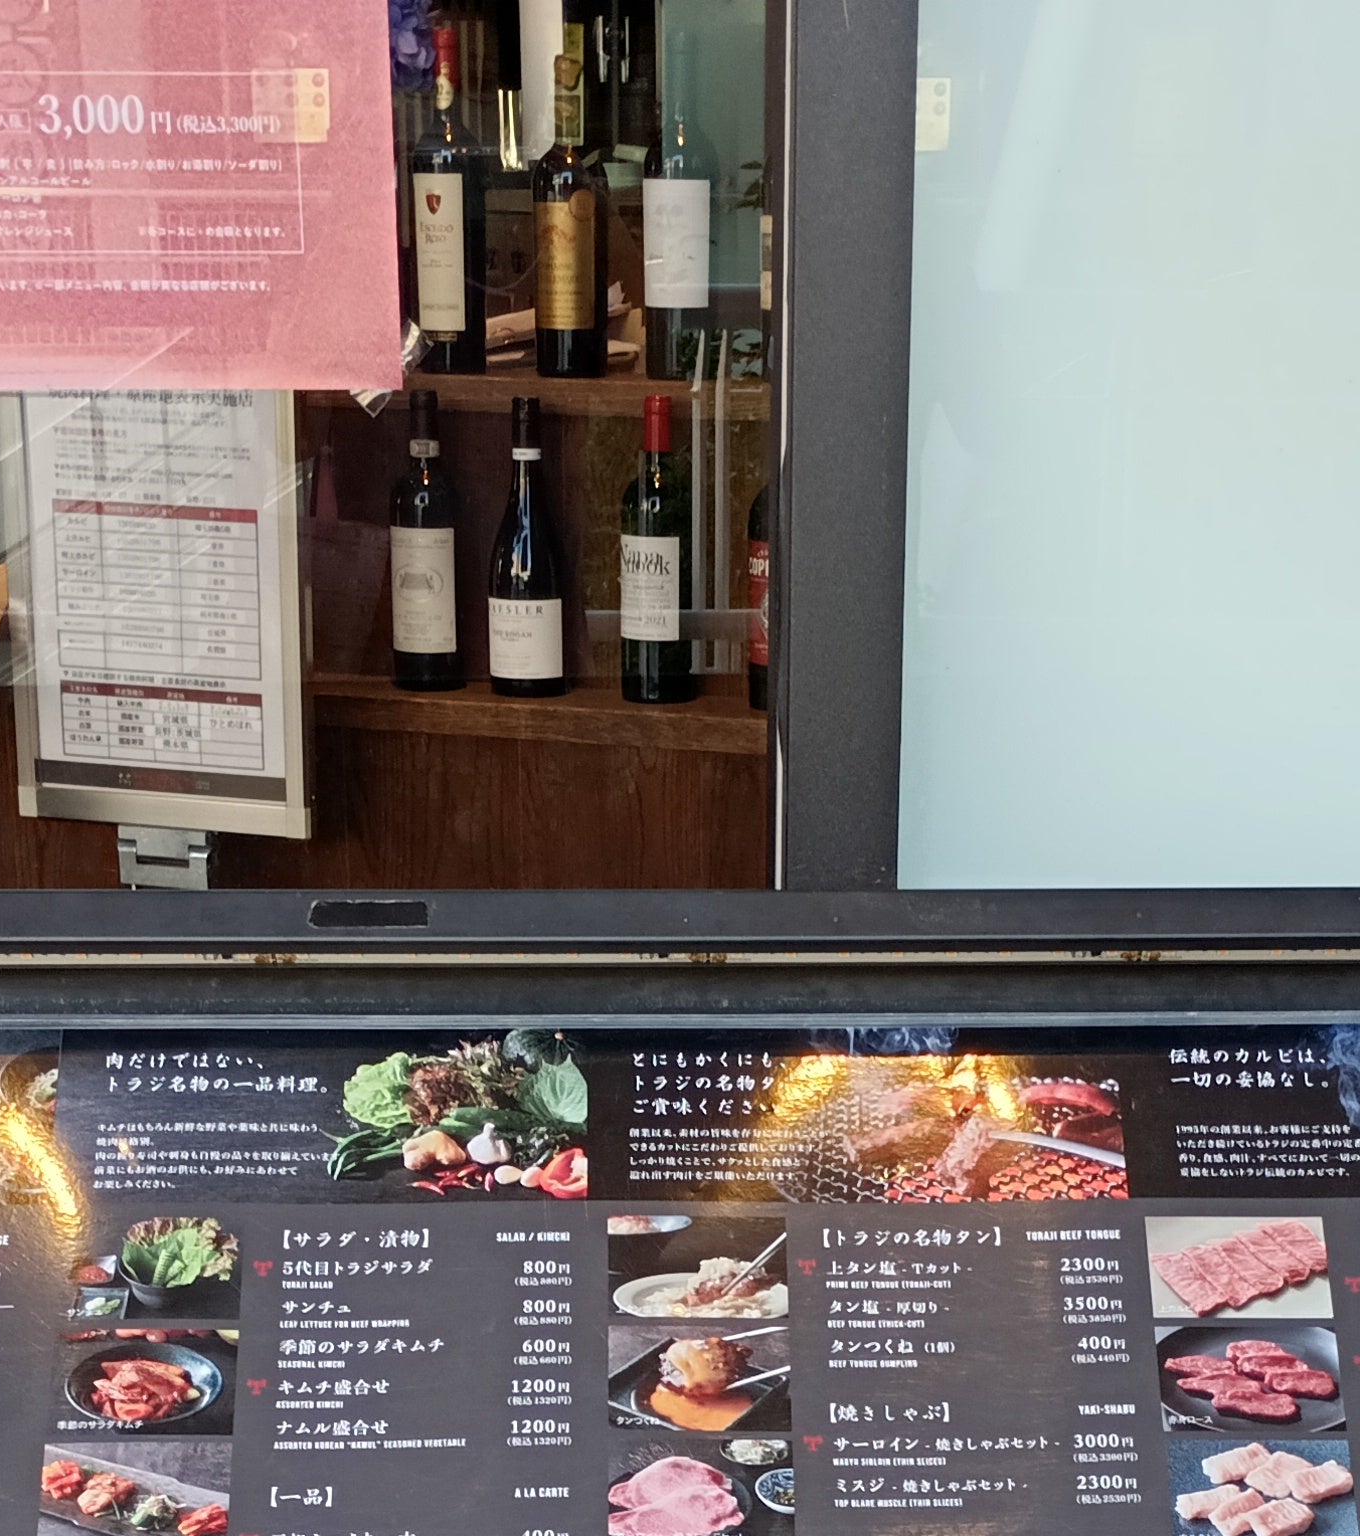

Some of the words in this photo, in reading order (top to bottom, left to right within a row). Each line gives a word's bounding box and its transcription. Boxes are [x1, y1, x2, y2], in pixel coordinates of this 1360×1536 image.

[105, 1052, 264, 1070] 肉だけではない、
[1168, 1047, 1326, 1065] 伝統のカルビは、
[108, 1075, 328, 1094] トラジ名物の一品料理。
[1170, 1070, 1329, 1089] 一切の妥協なし。
[822, 1226, 1001, 1249] 【トラジの名物タン】
[282, 1258, 433, 1277] 5代目トラジサラダ
[1060, 1257, 1119, 1272] 2300円
[281, 1300, 351, 1315] サンチュ
[522, 1299, 570, 1314] 800円
[279, 1338, 445, 1356] 季節のサラダキムチ
[1077, 1335, 1126, 1350] 400円
[278, 1378, 390, 1396] キムチ盛合せ
[511, 1378, 570, 1394] 1200円
[829, 1401, 950, 1424] 【焼きしゃぶ】
[276, 1419, 389, 1437] ナムル盛合せ
[1076, 1474, 1138, 1490] 2300円
[270, 1486, 333, 1508] 【一品】
